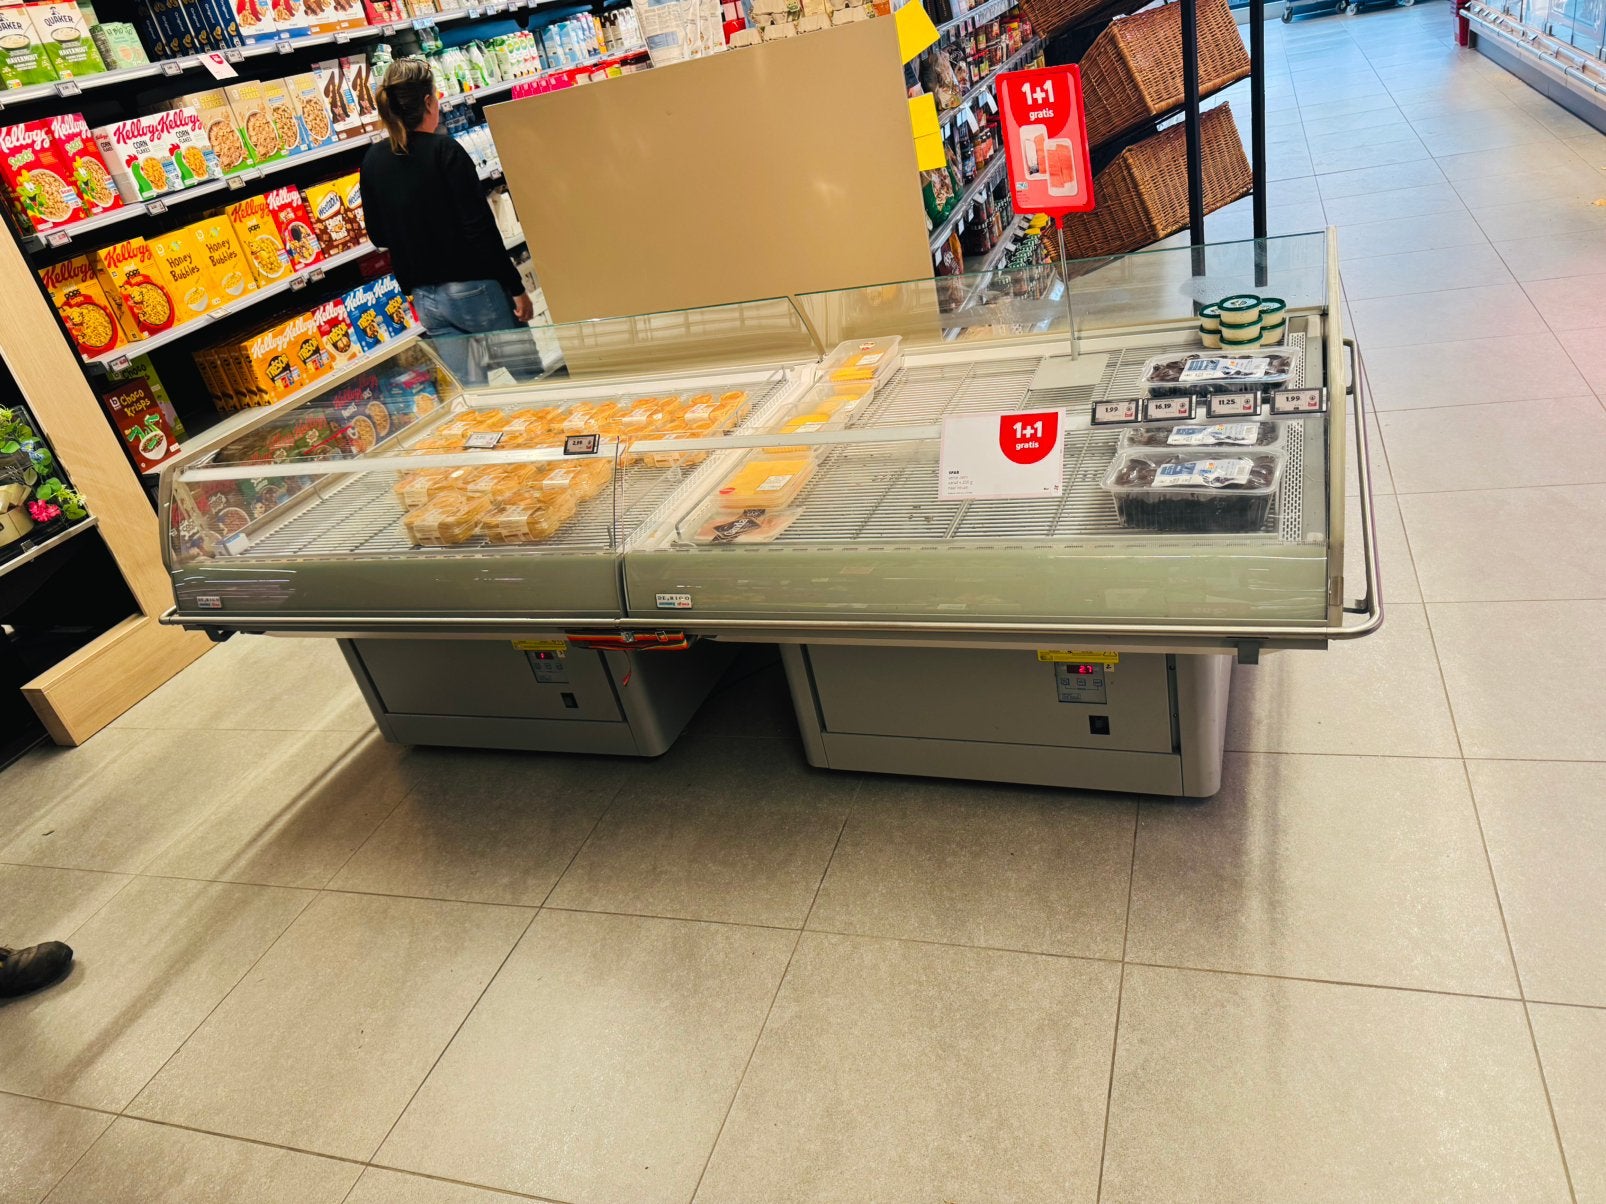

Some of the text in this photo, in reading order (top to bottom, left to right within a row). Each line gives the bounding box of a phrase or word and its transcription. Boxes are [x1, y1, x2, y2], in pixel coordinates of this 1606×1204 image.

[0, 22, 23, 31] UAKER
[44, 15, 74, 26] QUAKER
[1021, 79, 1055, 105] 1+1
[1029, 107, 1054, 121] gratis
[176, 129, 190, 139] CORN
[179, 136, 192, 144] FLAKES
[133, 140, 149, 149] CORN
[205, 238, 230, 254] Honey
[166, 252, 192, 268] Honey
[209, 250, 237, 267] Bubbles
[170, 265, 200, 282] Bubbles
[120, 389, 145, 405] Choco
[1012, 420, 1043, 439] 1+1
[1015, 441, 1039, 450] gratis
